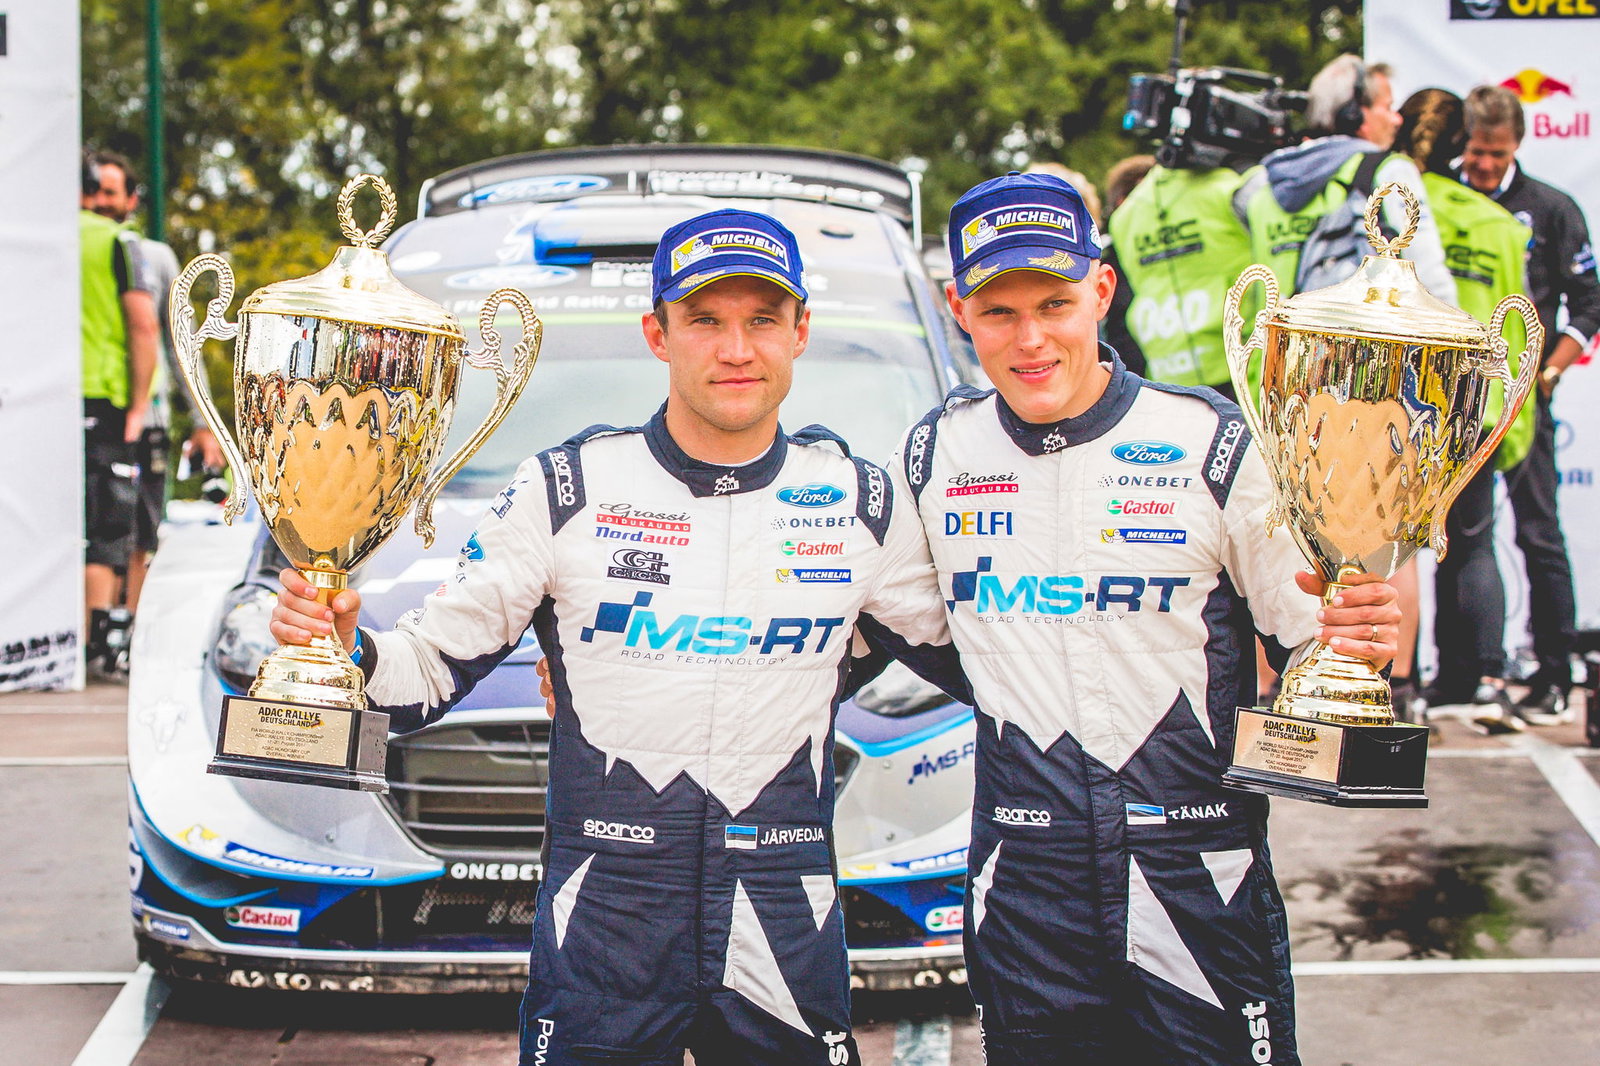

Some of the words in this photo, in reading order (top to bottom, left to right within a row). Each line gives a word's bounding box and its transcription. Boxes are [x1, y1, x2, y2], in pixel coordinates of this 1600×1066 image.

[1508, 0, 1597, 16] OPEL
[1533, 112, 1590, 138] Bull
[995, 210, 1072, 230] MICHELIN
[711, 233, 785, 259] MICHELIN
[1135, 290, 1210, 343] 060
[911, 425, 930, 485] sparco
[1125, 443, 1171, 463] Ford
[1209, 421, 1241, 483] sparco
[552, 451, 576, 506] sparco
[948, 472, 1018, 488] Grossi
[1118, 475, 1193, 489] ONEBET
[789, 488, 833, 504] Ford
[599, 503, 691, 521] Grossi
[1122, 500, 1176, 515] Castrol
[597, 515, 690, 531] TOIDUKAUBAD
[789, 516, 858, 529] ONEBET
[945, 511, 1013, 536] DELFI
[1126, 531, 1186, 541] MICHELIN
[796, 541, 845, 556] Castrol
[800, 571, 850, 581] MICHELIN
[976, 575, 1191, 615] MS-RT
[977, 615, 1015, 624] ROAD
[1025, 613, 1126, 625] TECHNOLOGY
[624, 610, 846, 655] MS-RT
[621, 650, 665, 661] ROAD
[676, 654, 788, 666] TECHNOLOGY
[258, 706, 284, 717] ADAC
[285, 709, 321, 721] RALLYE
[260, 716, 311, 728] DEUTSCHLAND
[1263, 720, 1285, 732] ADAC
[1286, 723, 1317, 736] RALLYE
[1264, 729, 1309, 743] DEUTSCHLAND
[995, 806, 1051, 824] sparco
[1168, 803, 1229, 821] TÄNAK
[583, 819, 655, 842] sparco
[450, 862, 543, 881] ONEBET
[240, 908, 294, 927] Castrol
